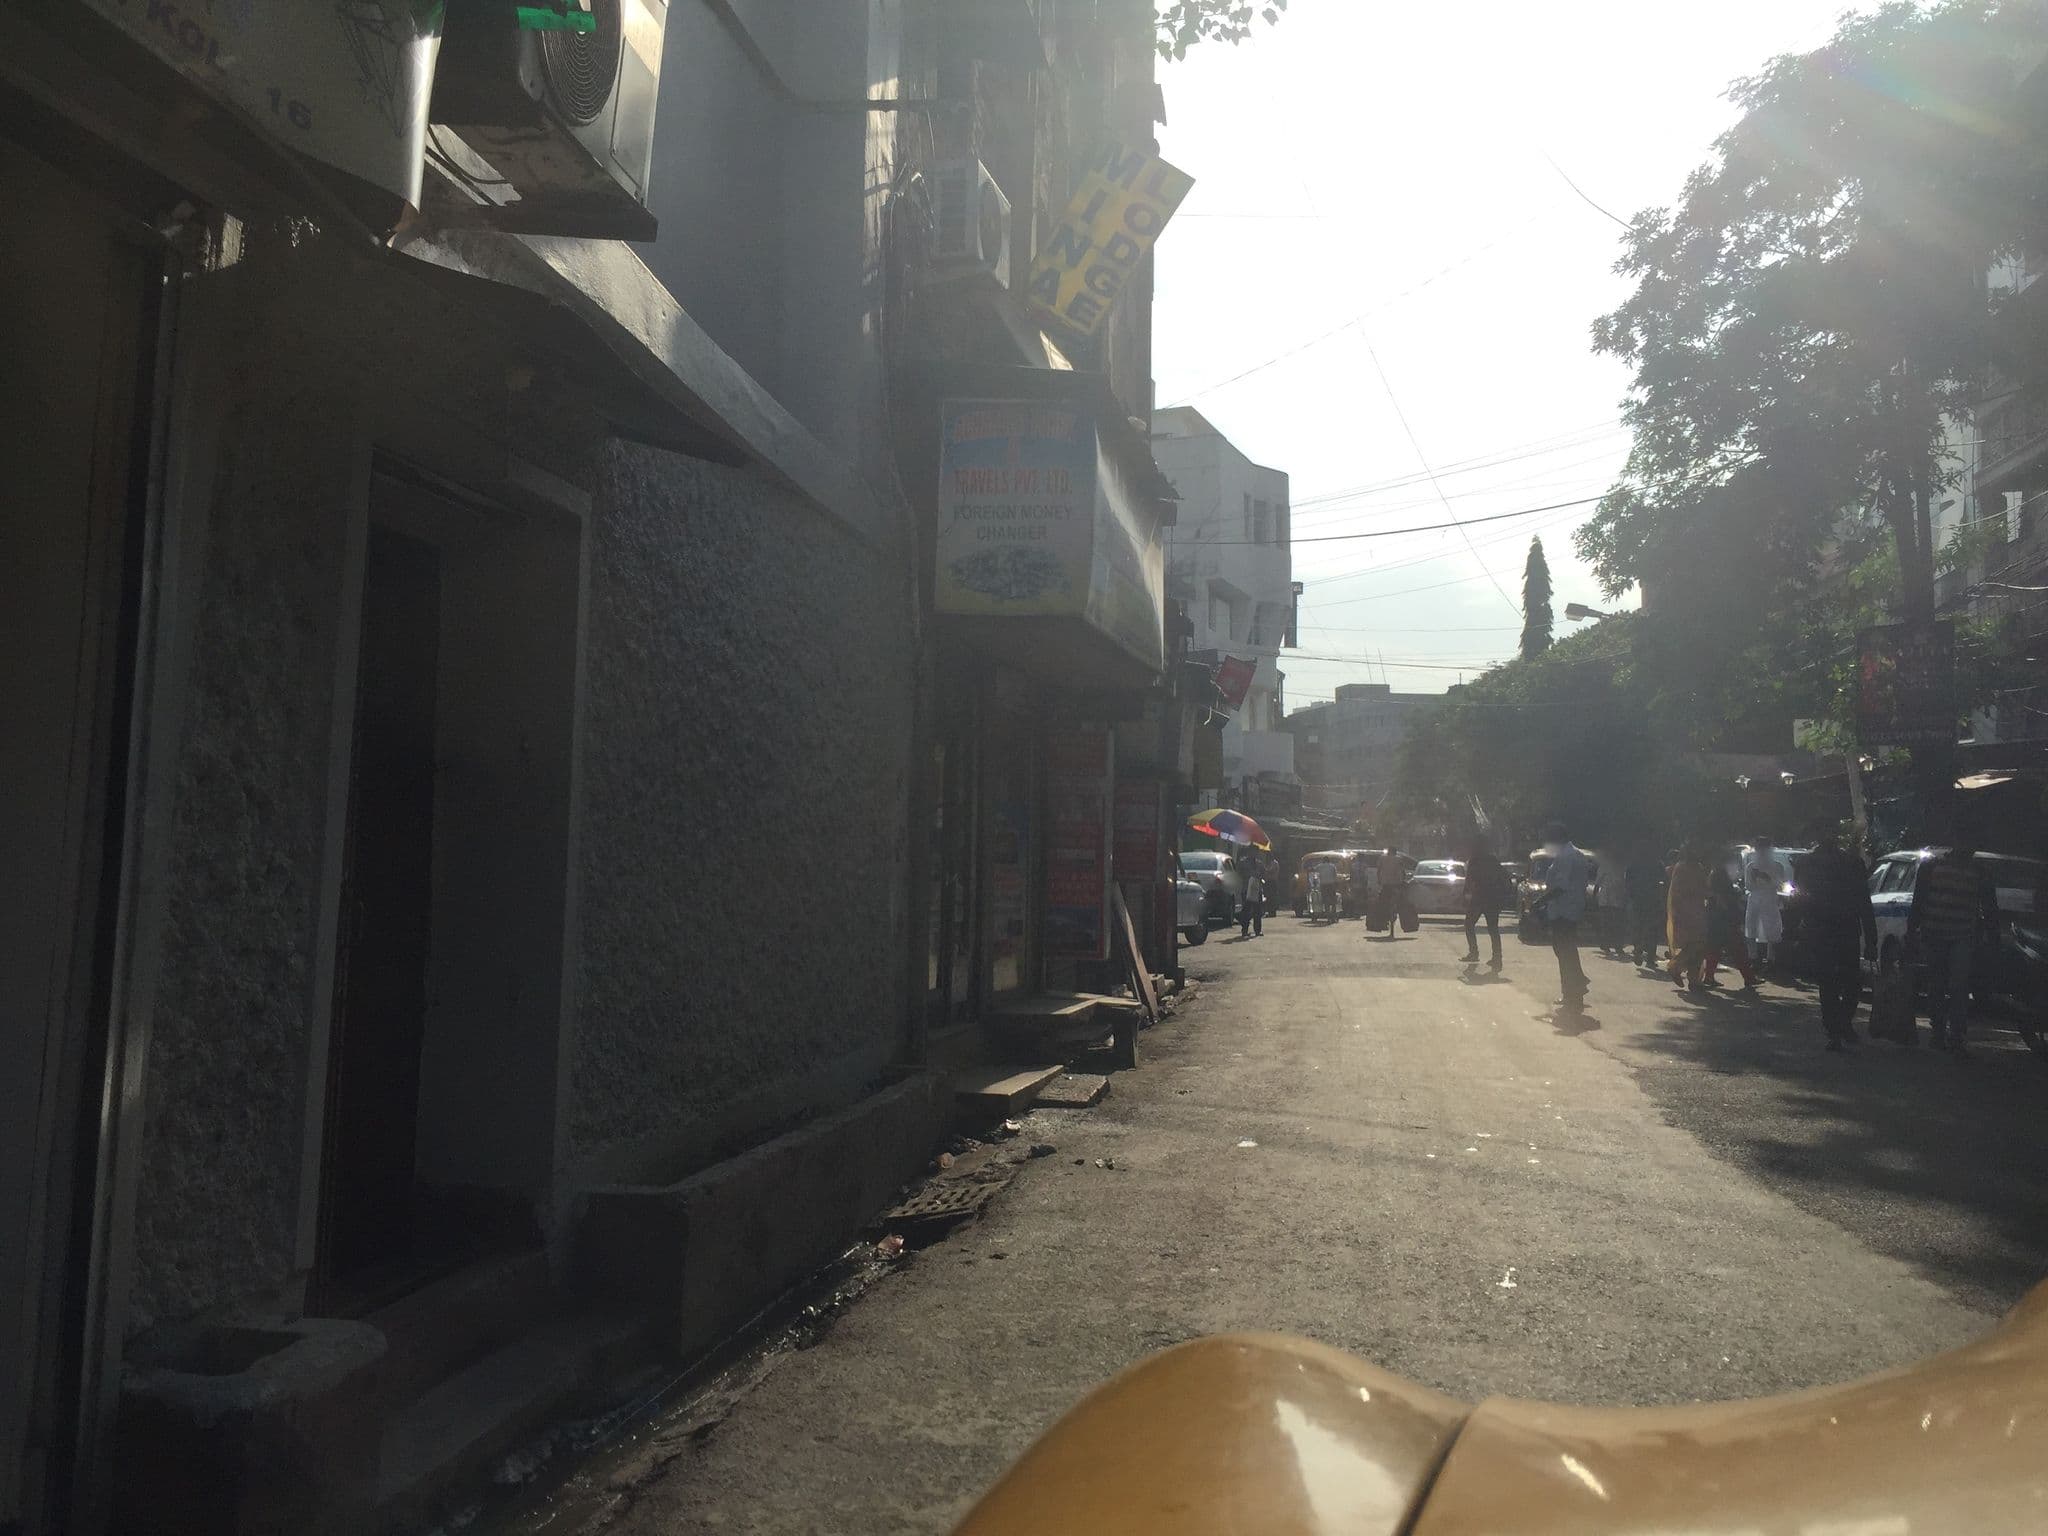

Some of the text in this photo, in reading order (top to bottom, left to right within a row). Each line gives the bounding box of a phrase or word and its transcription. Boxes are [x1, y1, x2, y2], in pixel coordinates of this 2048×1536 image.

[1066, 167, 1173, 329] LODGE
[953, 469, 1009, 496] TRAVELS
[953, 503, 1073, 521] FOREIGN MONEY
[976, 526, 1048, 541] CHANGER
